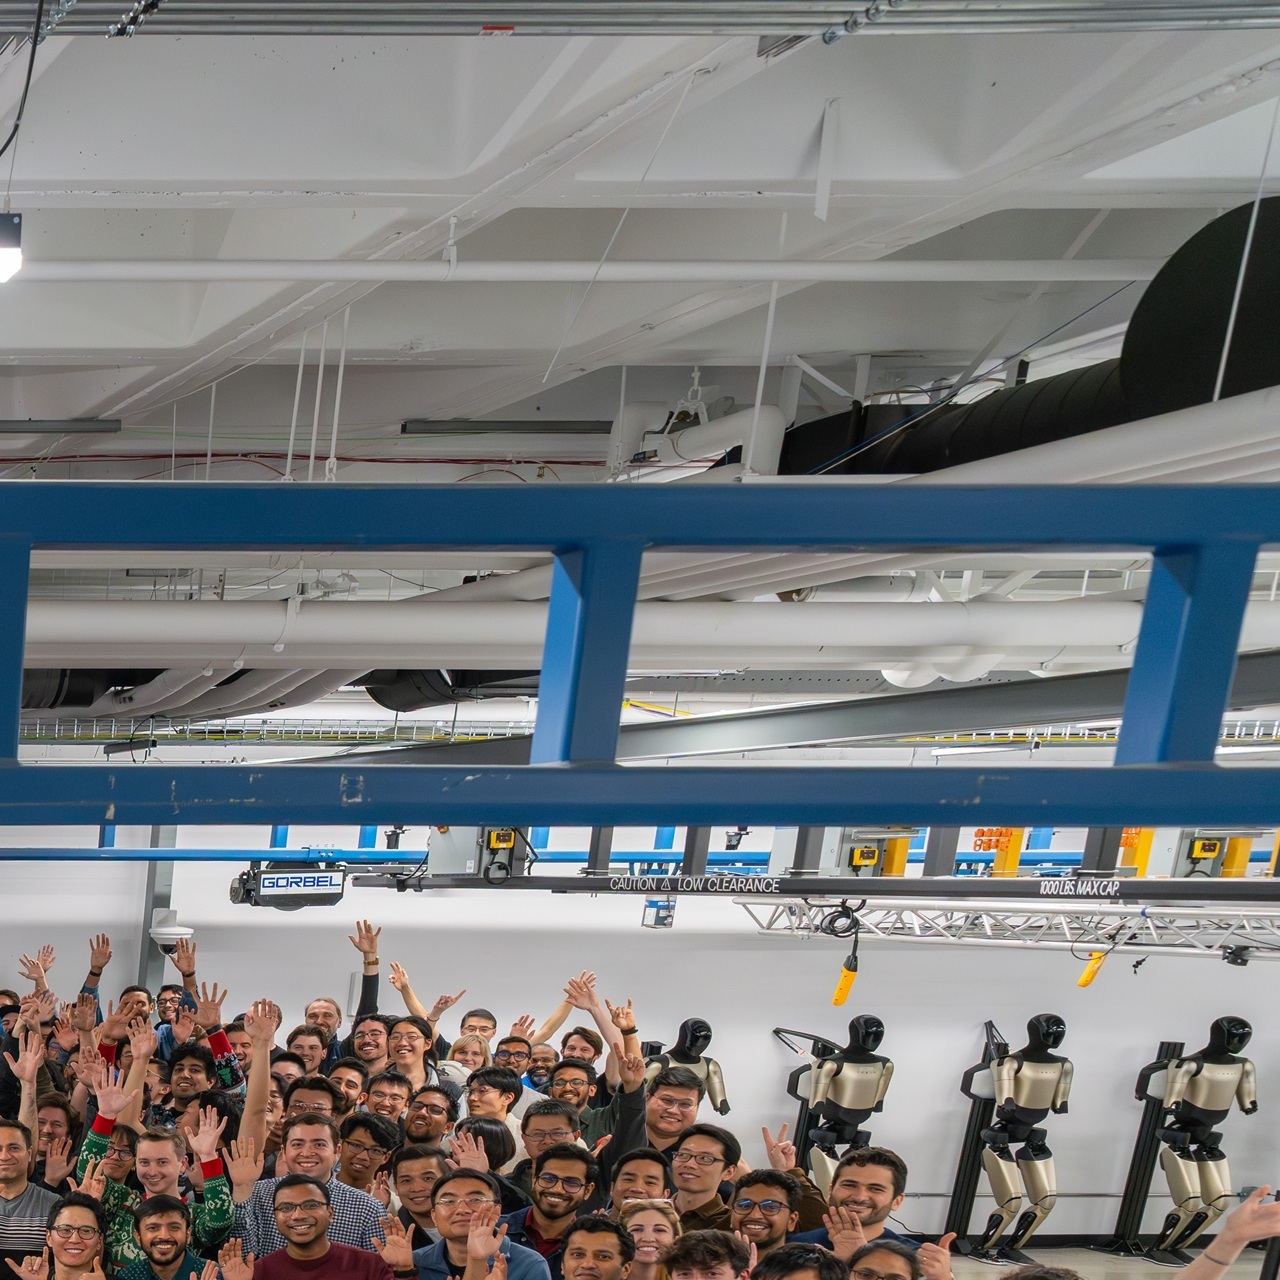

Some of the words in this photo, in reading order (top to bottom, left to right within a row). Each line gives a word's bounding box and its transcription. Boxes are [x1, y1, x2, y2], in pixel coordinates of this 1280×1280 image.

[262, 876, 341, 888] GORBEL
[610, 877, 657, 891] CAUTION
[677, 877, 704, 891] LOW
[707, 878, 781, 893] CLEARANCE
[1040, 881, 1059, 895] 1000
[1059, 881, 1075, 895] LBS.
[1076, 881, 1099, 896] MAX
[1099, 881, 1120, 896] CAP.
